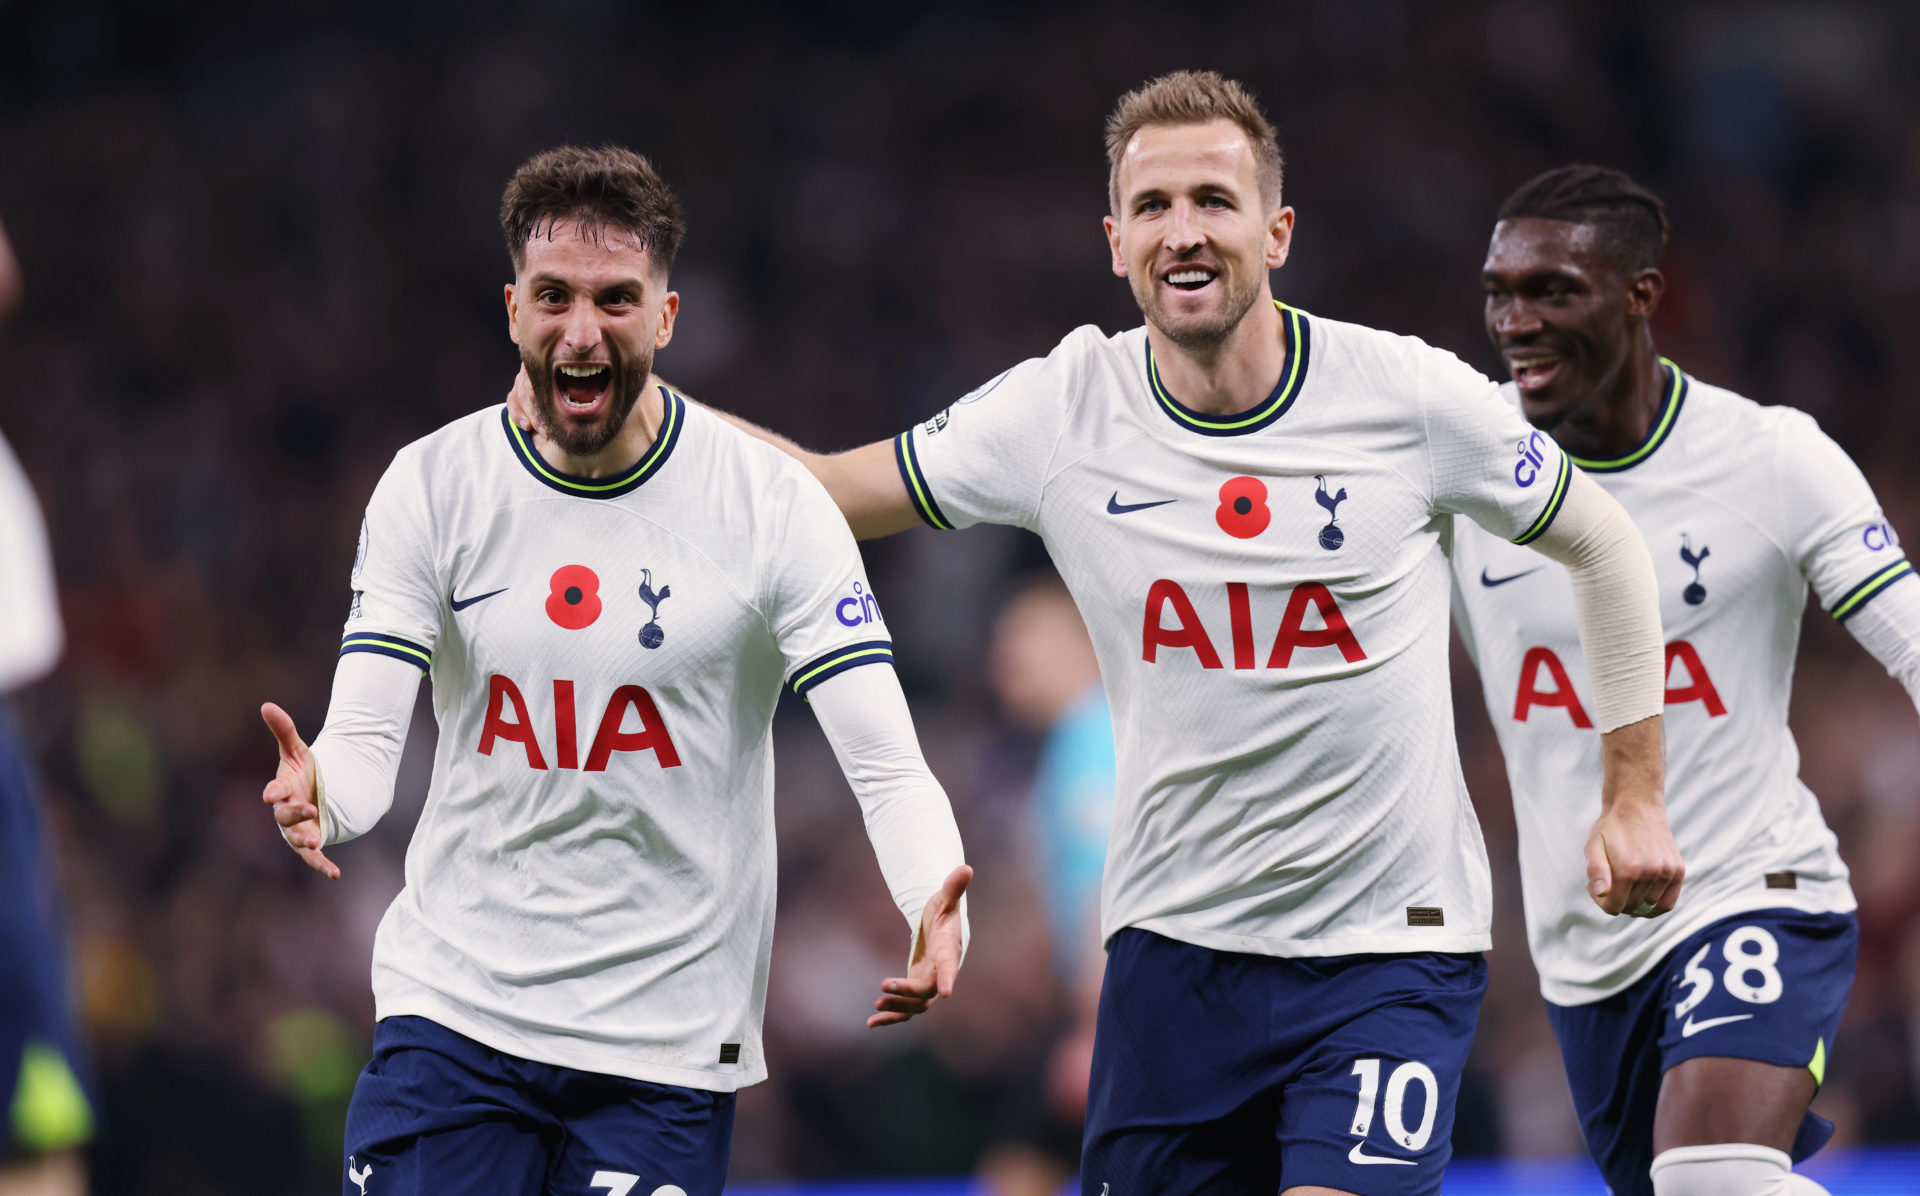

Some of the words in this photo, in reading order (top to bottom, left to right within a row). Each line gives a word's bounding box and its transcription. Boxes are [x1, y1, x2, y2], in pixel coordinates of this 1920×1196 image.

[1142, 579, 1368, 669] AIA
[477, 674, 682, 771] AIA
[1513, 640, 1728, 729] AA
[1350, 1059, 1439, 1151] 10
